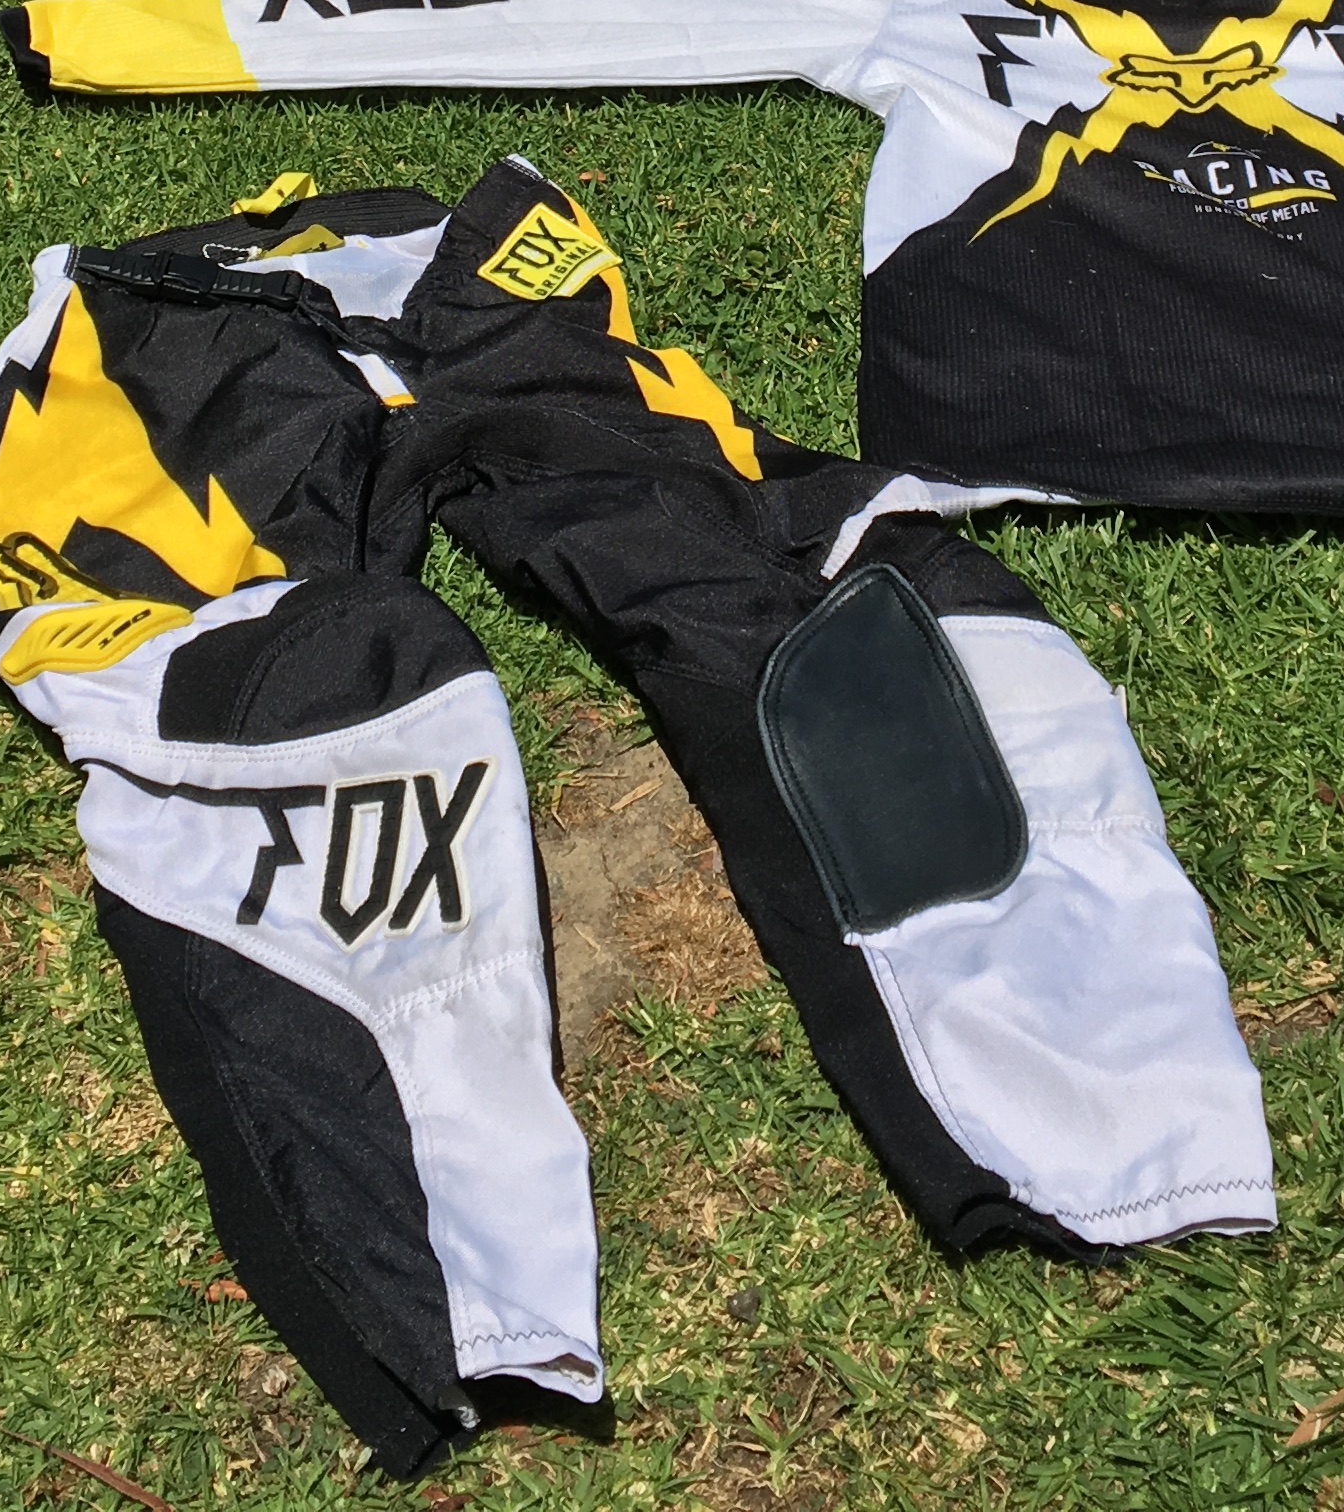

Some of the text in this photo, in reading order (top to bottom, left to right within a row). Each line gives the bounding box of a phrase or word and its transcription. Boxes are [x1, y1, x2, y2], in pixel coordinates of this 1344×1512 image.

[1271, 200, 1320, 223] METAL
[490, 216, 580, 289] FOX
[534, 241, 598, 297] ORIGINAL
[234, 758, 496, 950] FOX
